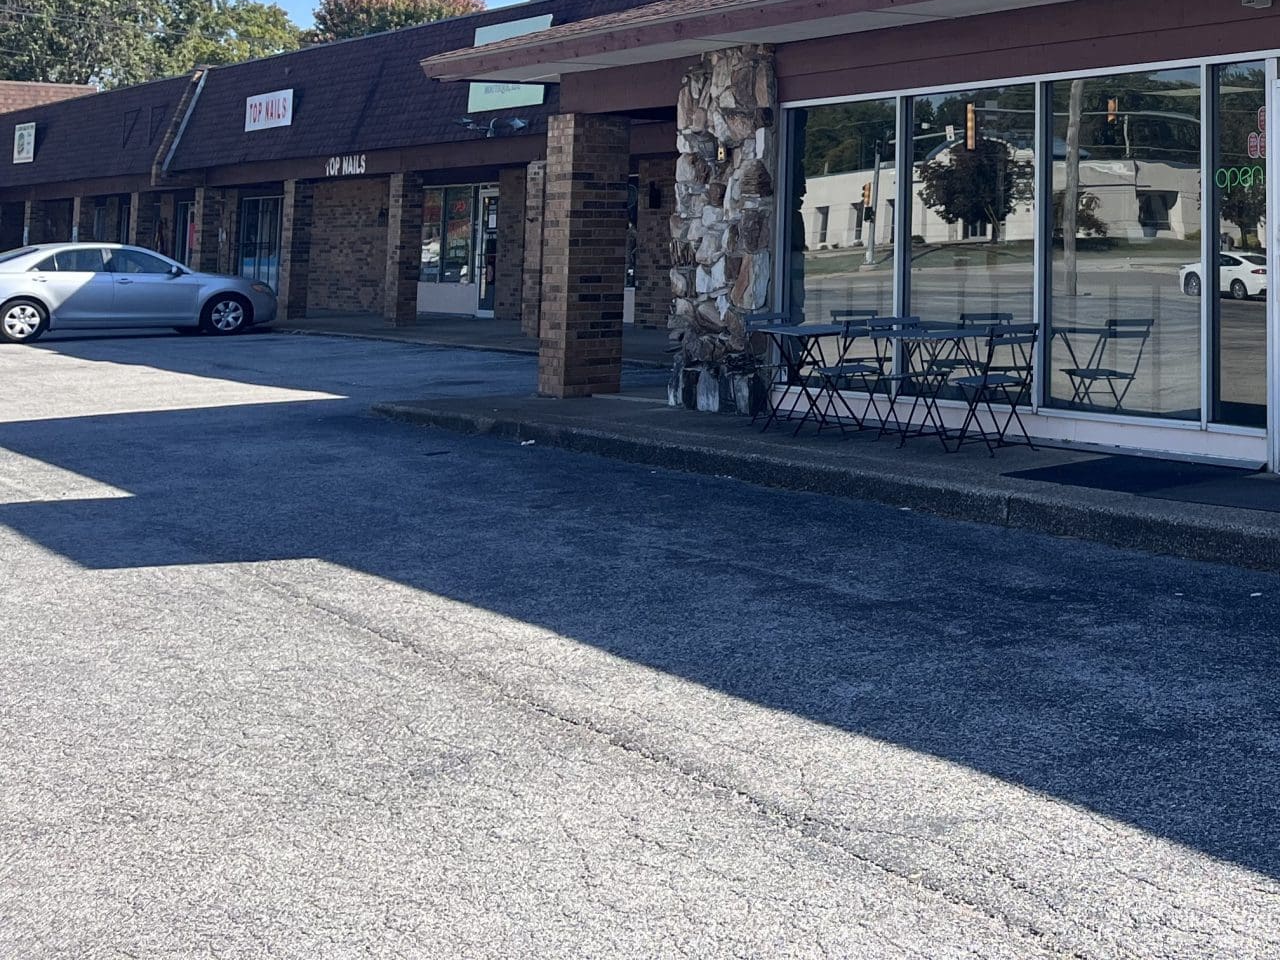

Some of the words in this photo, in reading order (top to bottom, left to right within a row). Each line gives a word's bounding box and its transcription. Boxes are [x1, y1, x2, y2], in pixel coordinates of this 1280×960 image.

[250, 102, 263, 124] TOP
[265, 97, 287, 121] NAILS
[325, 156, 340, 177] TOP
[342, 154, 366, 176] NAILS
[1216, 166, 1264, 194] open
